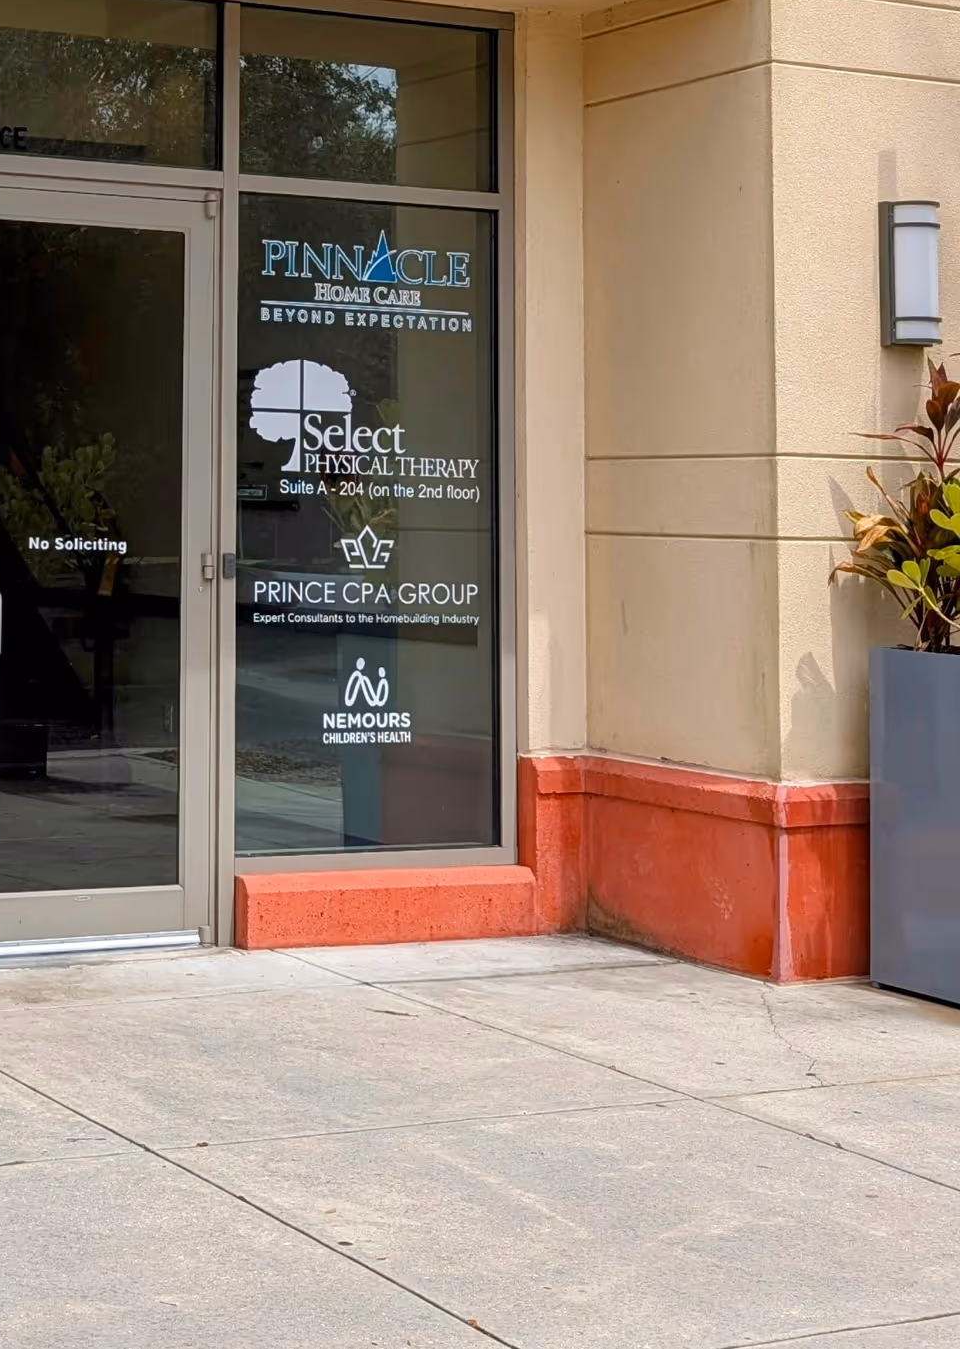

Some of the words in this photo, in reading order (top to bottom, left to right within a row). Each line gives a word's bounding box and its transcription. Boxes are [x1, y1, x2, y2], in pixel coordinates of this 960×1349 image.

[262, 230, 470, 288] PINNACLE
[314, 283, 370, 302] HOME
[373, 286, 421, 306] CARE
[260, 308, 335, 324] BEYOND
[345, 312, 472, 332] EXPECTATION
[303, 414, 406, 454] Select
[304, 453, 394, 476] PHYSICAL
[396, 456, 480, 478] THERAPY
[280, 480, 314, 494] Suite
[317, 482, 328, 494] A
[340, 482, 364, 496] 204
[368, 482, 390, 498] (on
[394, 484, 414, 498] the
[418, 484, 442, 498] 2nd
[447, 485, 480, 502] floor)
[29, 537, 49, 550] No
[55, 538, 127, 554] Soliciting
[254, 581, 336, 603] PRINCE
[342, 582, 391, 604] CPA
[399, 583, 478, 604] GROUP
[253, 613, 285, 623] Expert
[288, 613, 343, 623] Consultants
[346, 614, 355, 623] to
[358, 614, 374, 623] the
[376, 614, 439, 625] Homebuilding
[442, 614, 479, 625] Industry
[323, 713, 411, 729] NEMOURS
[323, 732, 375, 744] CHILDREN'S
[378, 732, 411, 743] HEALTH
